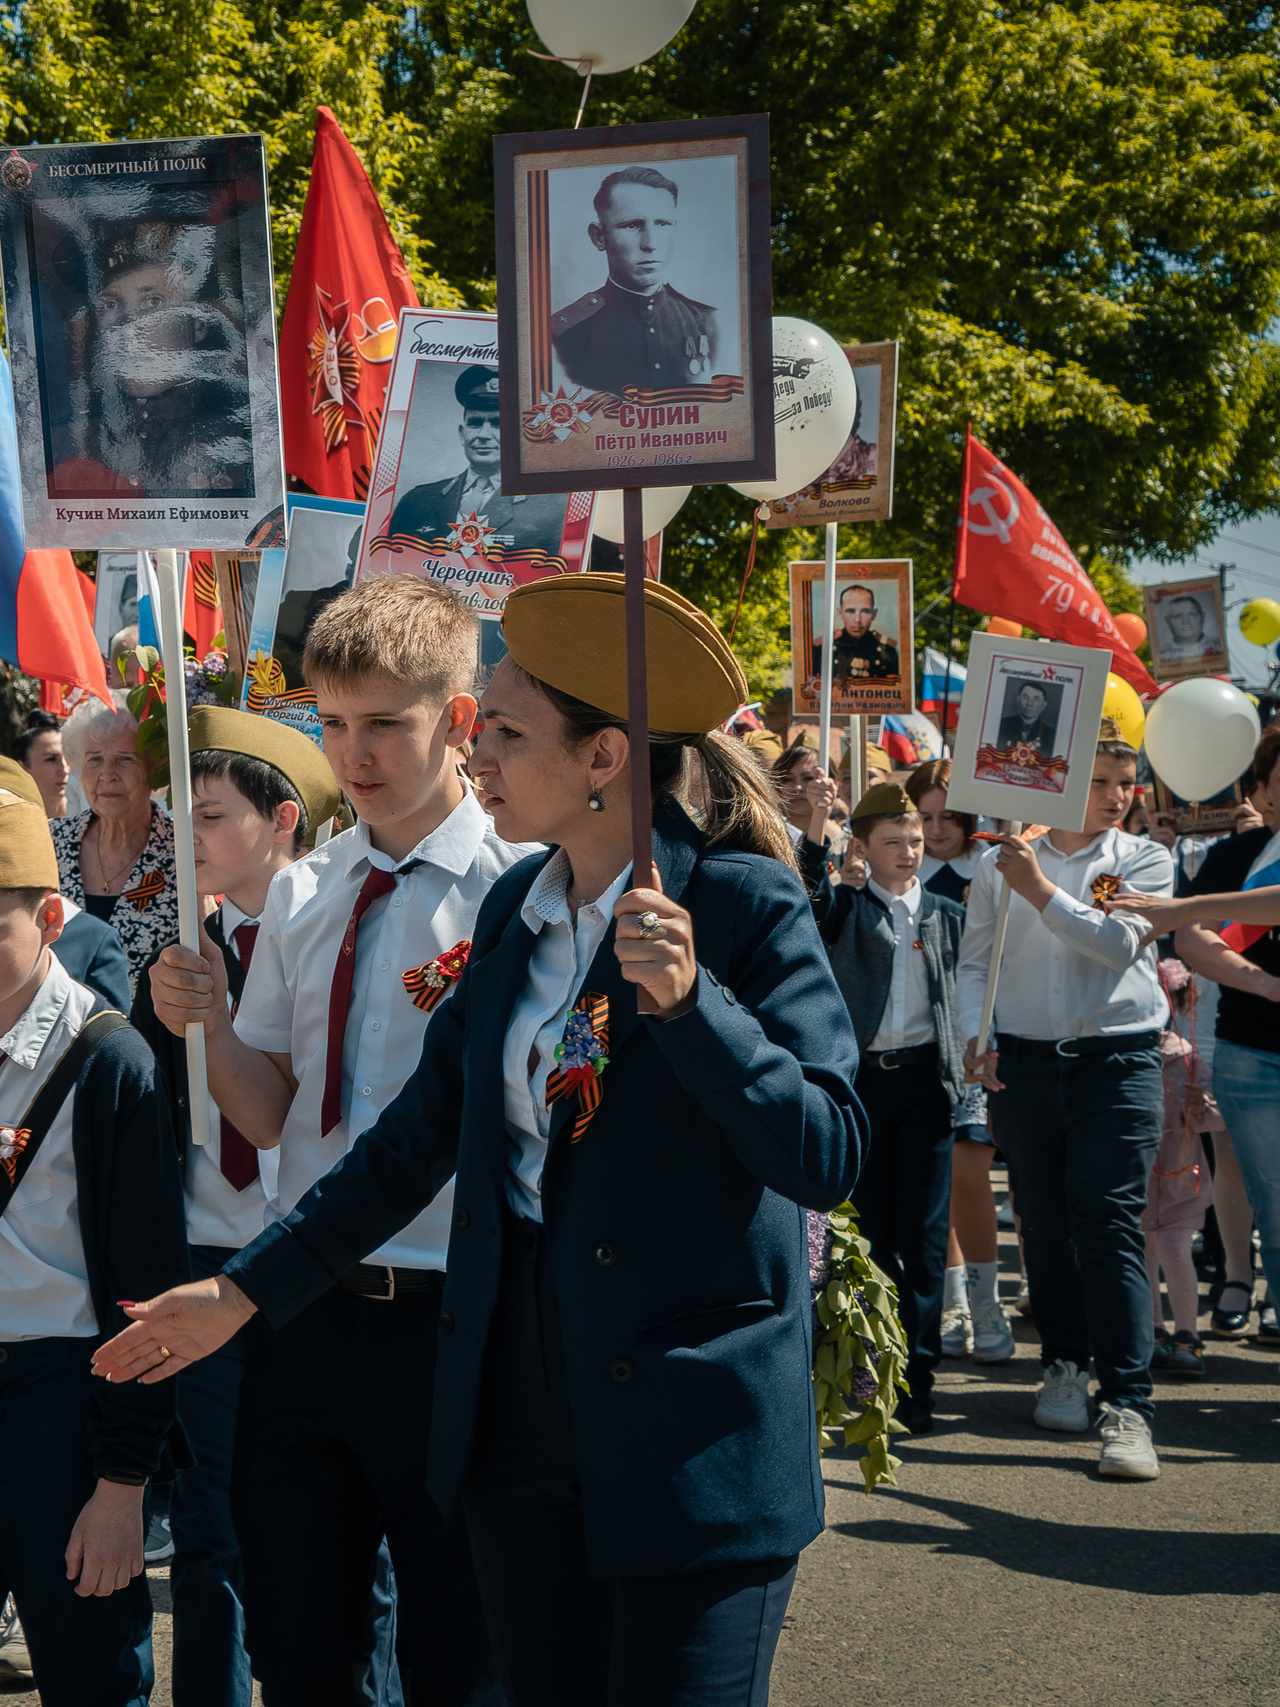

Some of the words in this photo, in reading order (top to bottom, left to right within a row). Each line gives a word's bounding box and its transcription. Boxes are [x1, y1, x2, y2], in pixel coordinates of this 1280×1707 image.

[48, 156, 160, 178] БЕССМЕРТНЫЙ
[163, 156, 207, 173] ПОЛК
[620, 403, 700, 430] Сурин
[595, 432, 636, 451] Пётр
[640, 429, 728, 449] Иванович
[607, 453, 636, 469] 1926
[818, 496, 871, 509] Волкова
[55, 507, 104, 523] Кучин
[106, 507, 166, 520] Михаил
[169, 506, 250, 523] Ефимович
[422, 558, 514, 588] Чередник
[1039, 573, 1075, 614] 79
[840, 687, 902, 702] Антонец
[263, 696, 311, 711] Мусихин
[261, 707, 305, 722] Георгий
